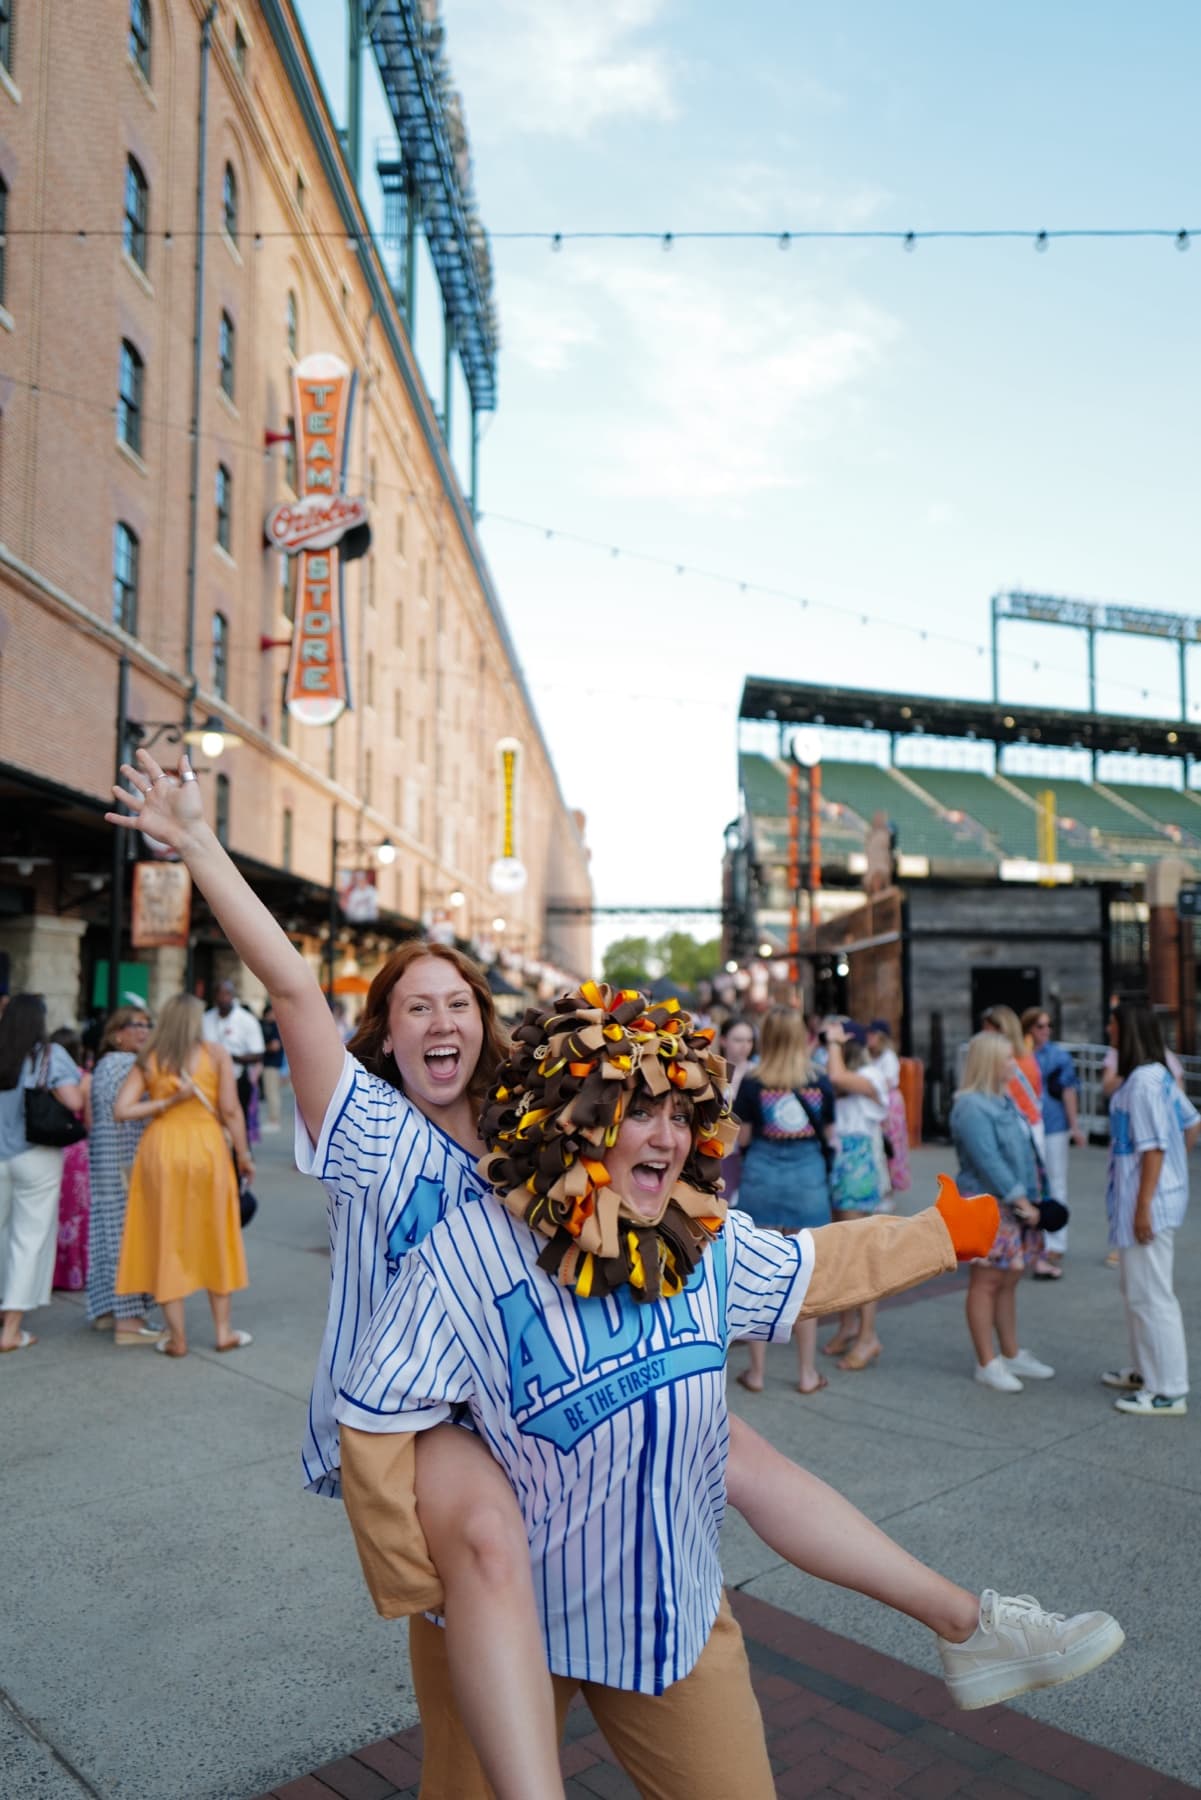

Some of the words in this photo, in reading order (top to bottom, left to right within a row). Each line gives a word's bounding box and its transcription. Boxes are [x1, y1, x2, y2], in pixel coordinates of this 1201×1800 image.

[304, 384, 336, 488] TEAM
[302, 555, 332, 691] STORE
[562, 1401, 589, 1432] BE
[585, 1383, 618, 1416] THE
